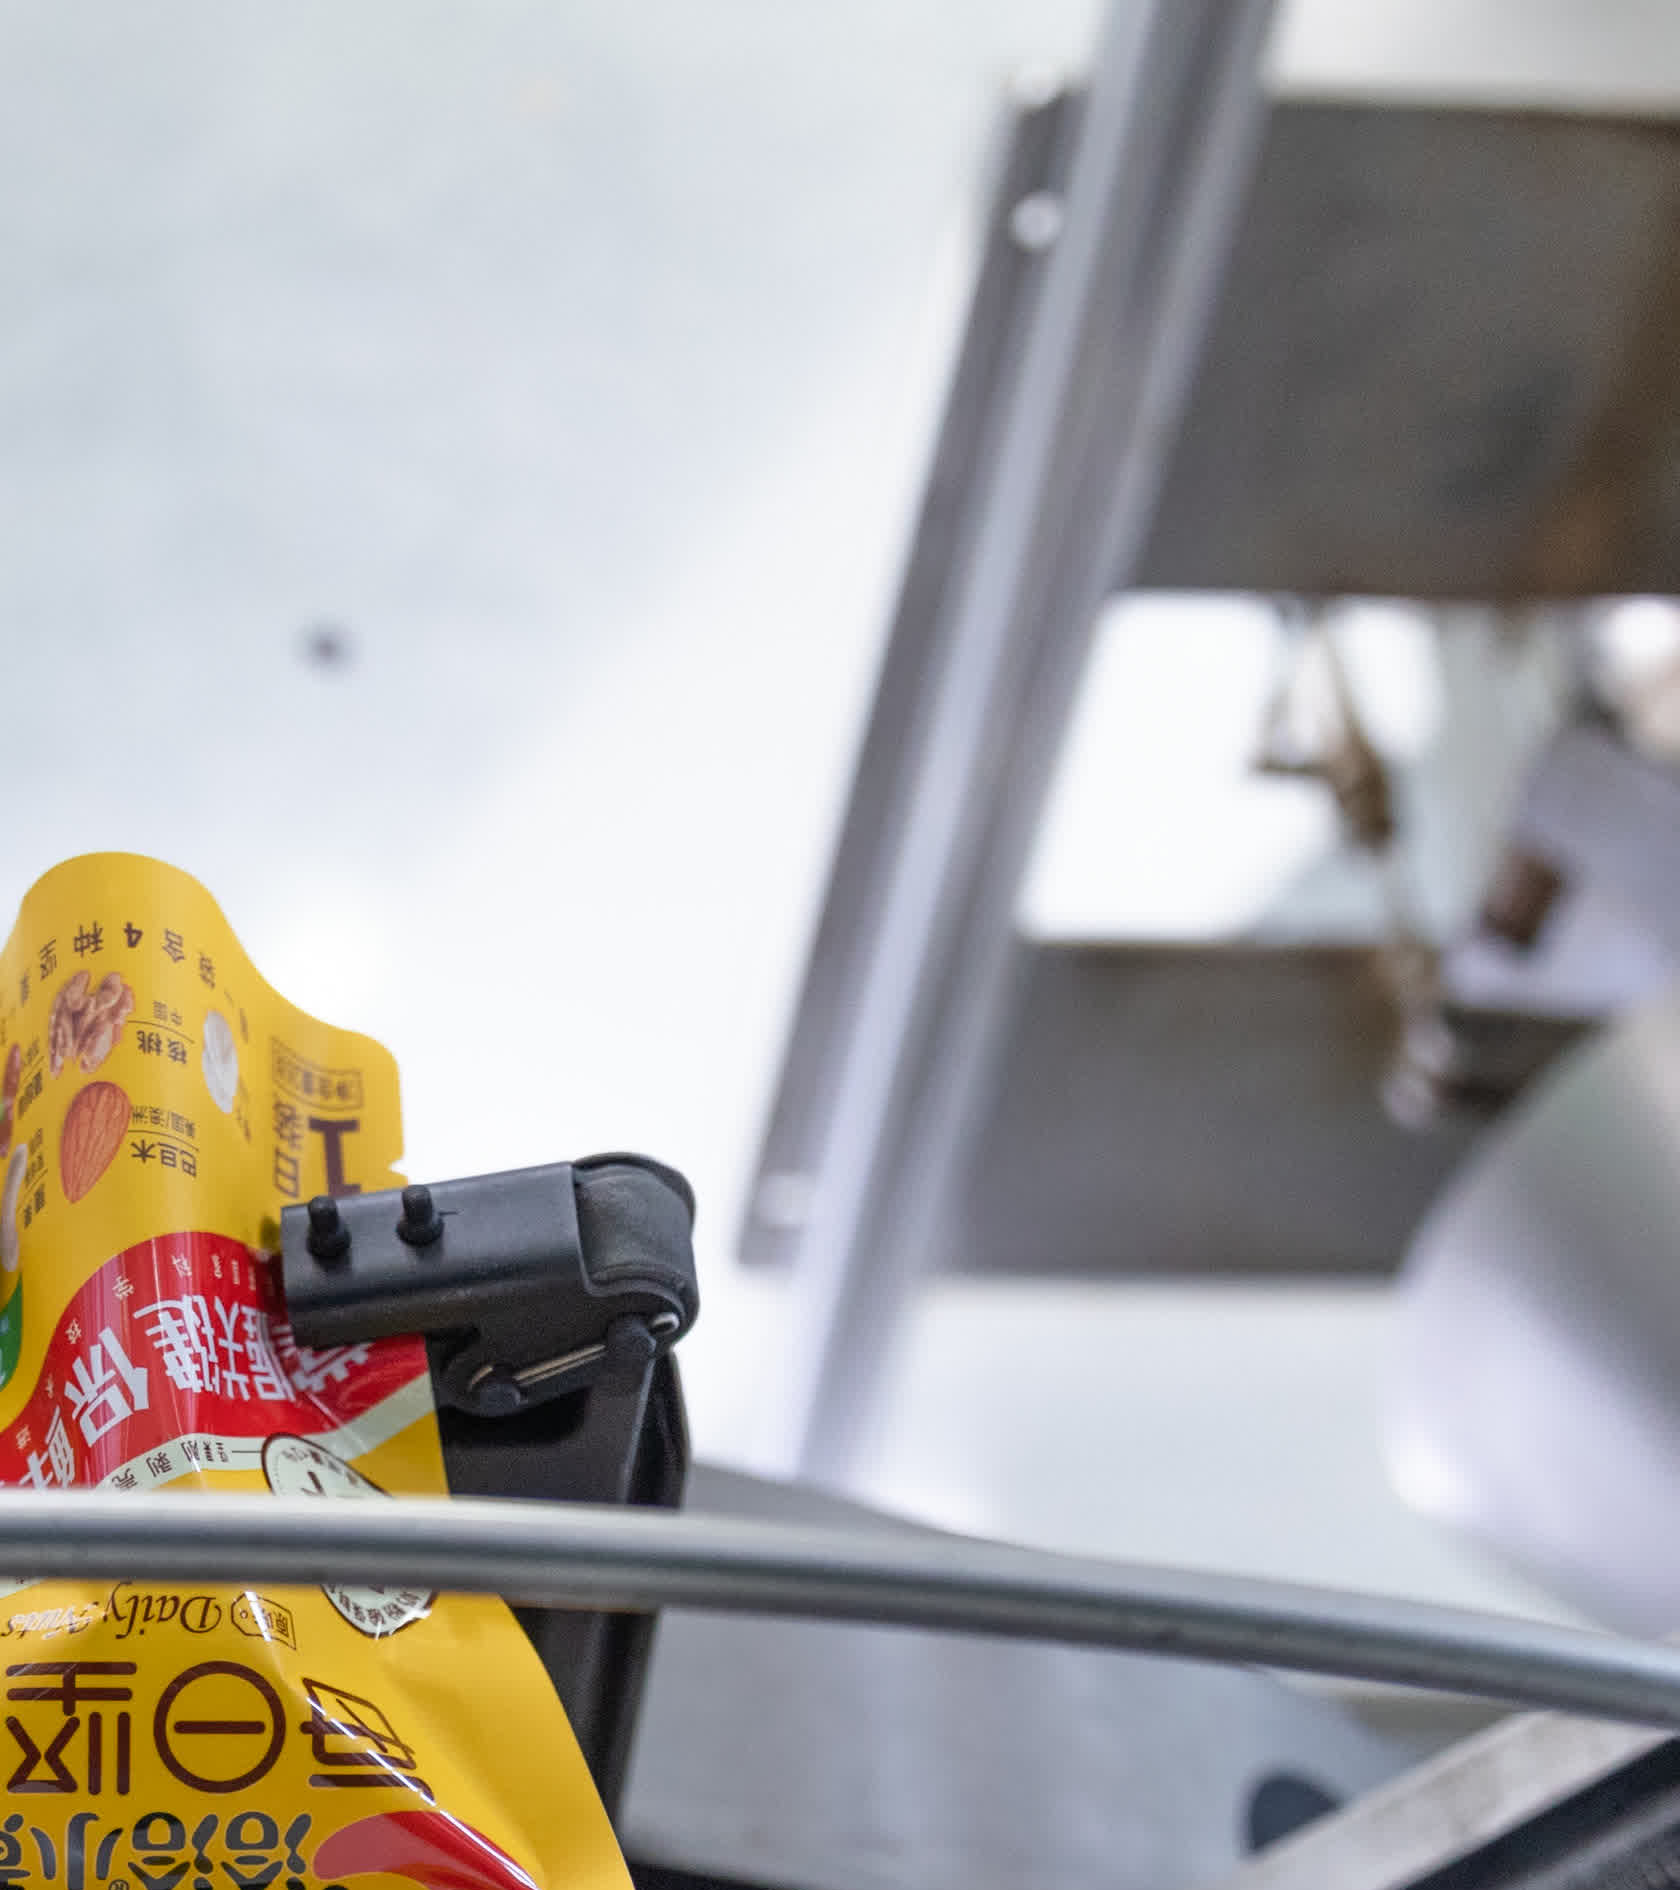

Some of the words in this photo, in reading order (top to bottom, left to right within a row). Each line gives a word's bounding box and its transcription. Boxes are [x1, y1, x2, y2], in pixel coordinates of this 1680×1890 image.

[134, 1029, 189, 1066] 核桃
[128, 1138, 198, 1180] 巴旦木
[100, 1580, 222, 1640] Daily
